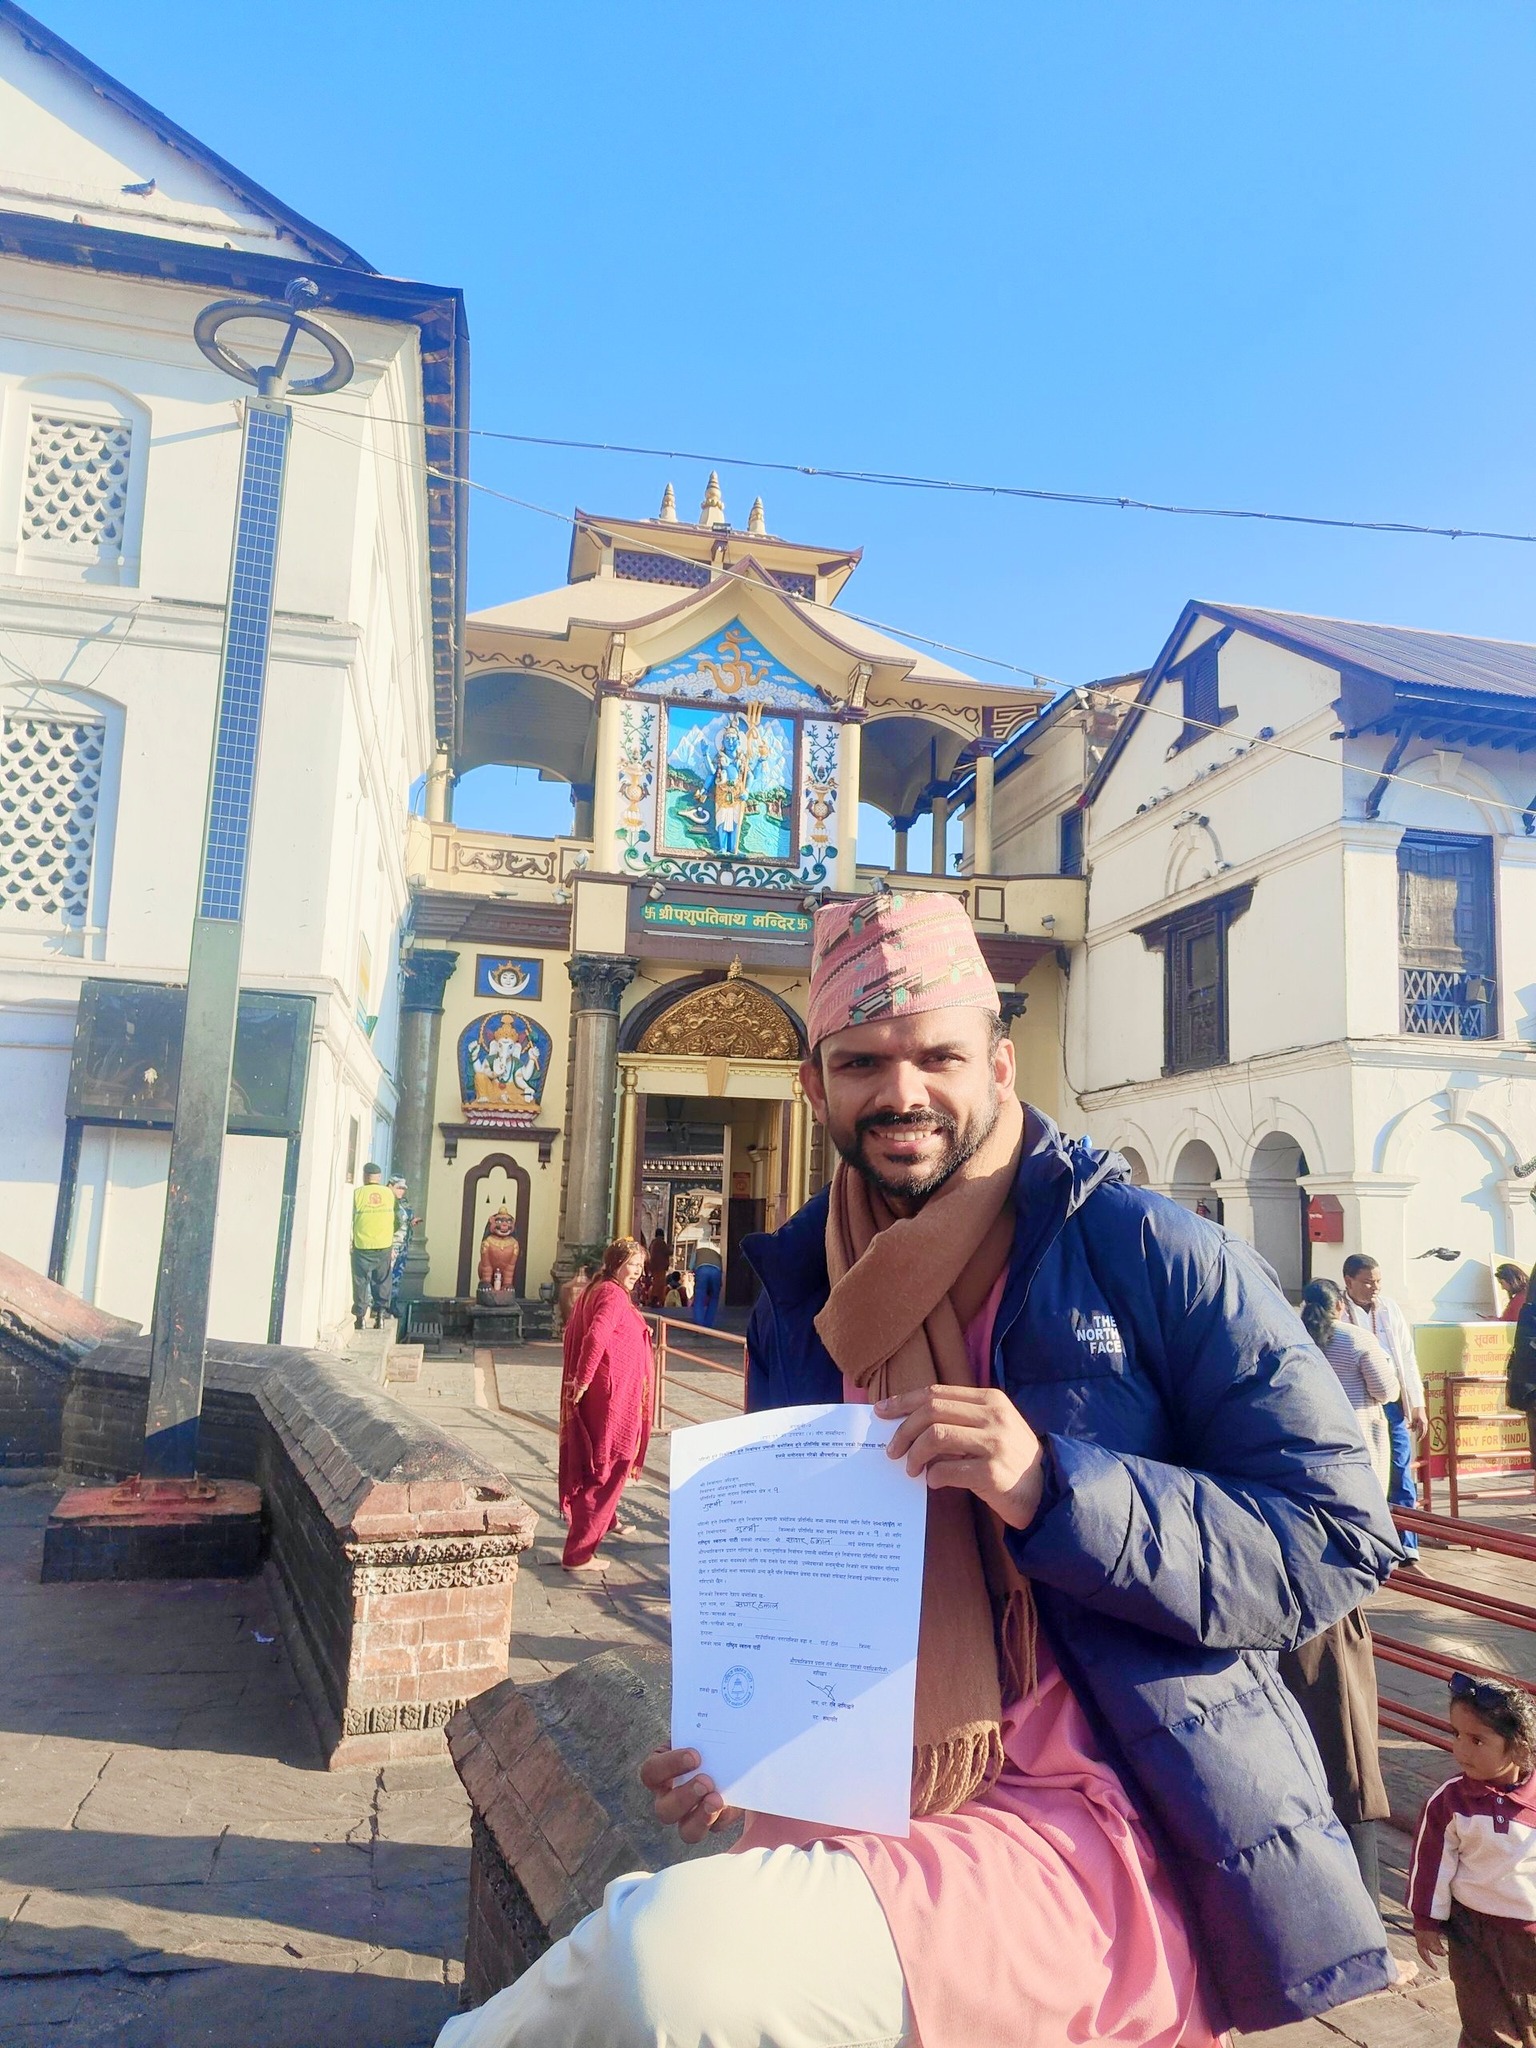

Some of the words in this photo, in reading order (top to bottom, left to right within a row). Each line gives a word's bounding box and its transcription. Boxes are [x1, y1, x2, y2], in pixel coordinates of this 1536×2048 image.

[753, 911, 795, 931] मन्दिर
[1093, 1315, 1117, 1328] THE
[1077, 1327, 1120, 1342] NORTH
[1089, 1341, 1122, 1354] FACE
[1456, 1437, 1479, 1447] ONLY
[1481, 1435, 1498, 1445] FOR
[1501, 1433, 1527, 1443] HINDU
